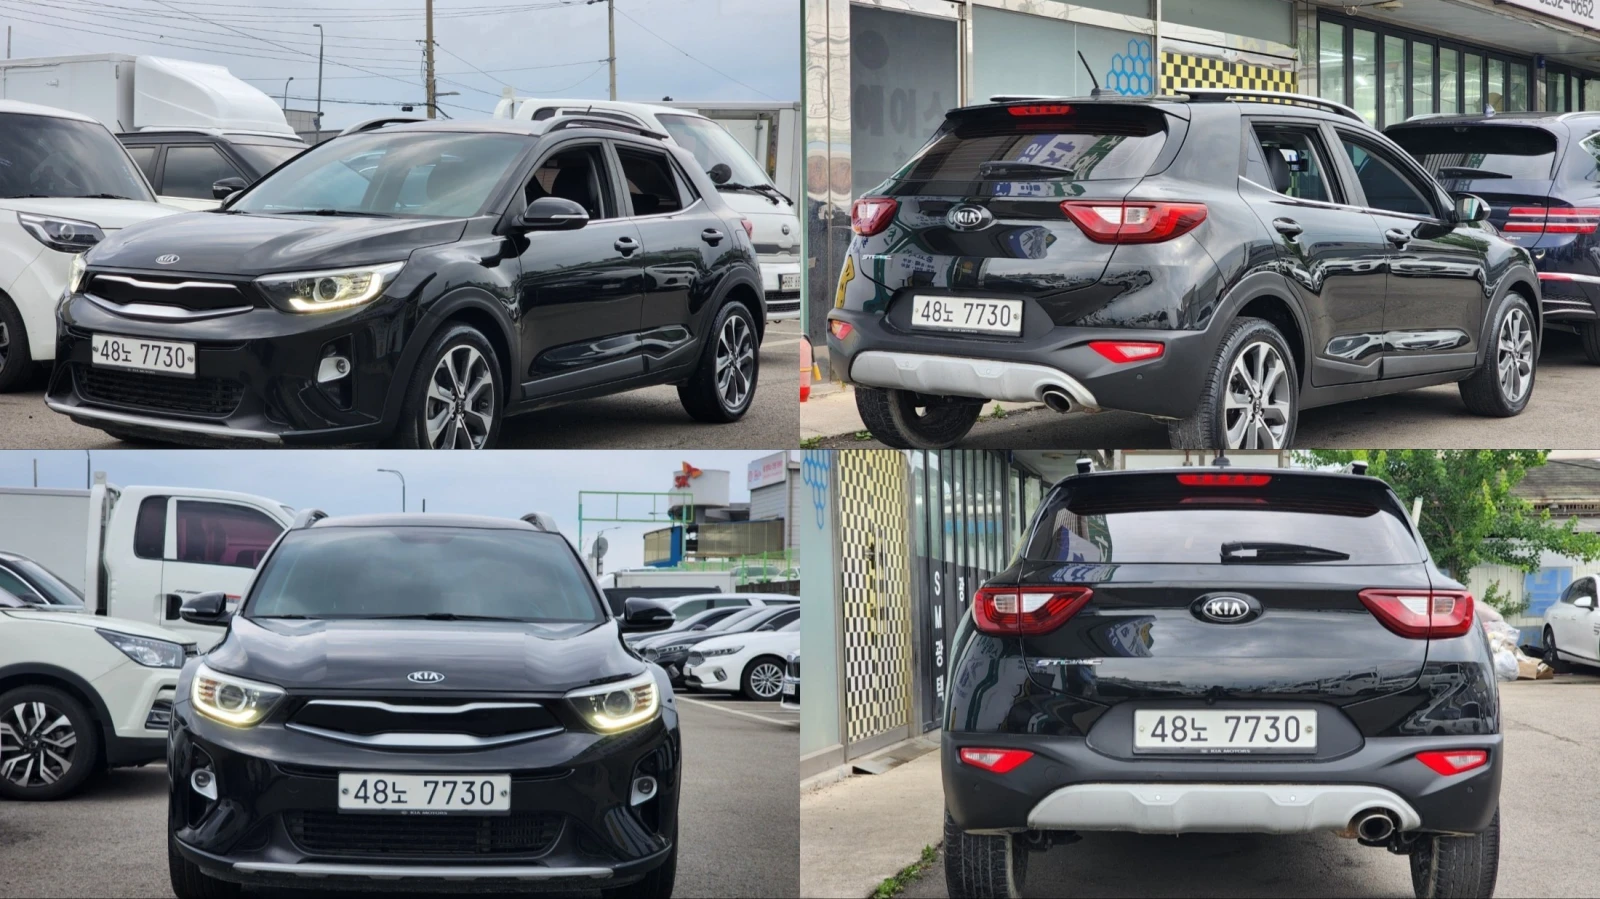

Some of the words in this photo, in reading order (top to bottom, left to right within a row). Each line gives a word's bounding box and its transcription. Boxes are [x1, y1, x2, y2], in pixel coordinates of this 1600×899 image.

[956, 211, 979, 224] KIA
[158, 254, 176, 263] KIA
[921, 300, 953, 323] 48노
[963, 302, 1011, 327] 7730
[100, 340, 132, 363] 48노
[140, 343, 185, 369] 7730
[1209, 602, 1243, 616] KIA
[412, 671, 440, 681] KIA
[1150, 715, 1208, 743] 48노
[1224, 715, 1300, 743] 7730
[354, 779, 407, 804] 48노
[423, 780, 495, 806] 7730
